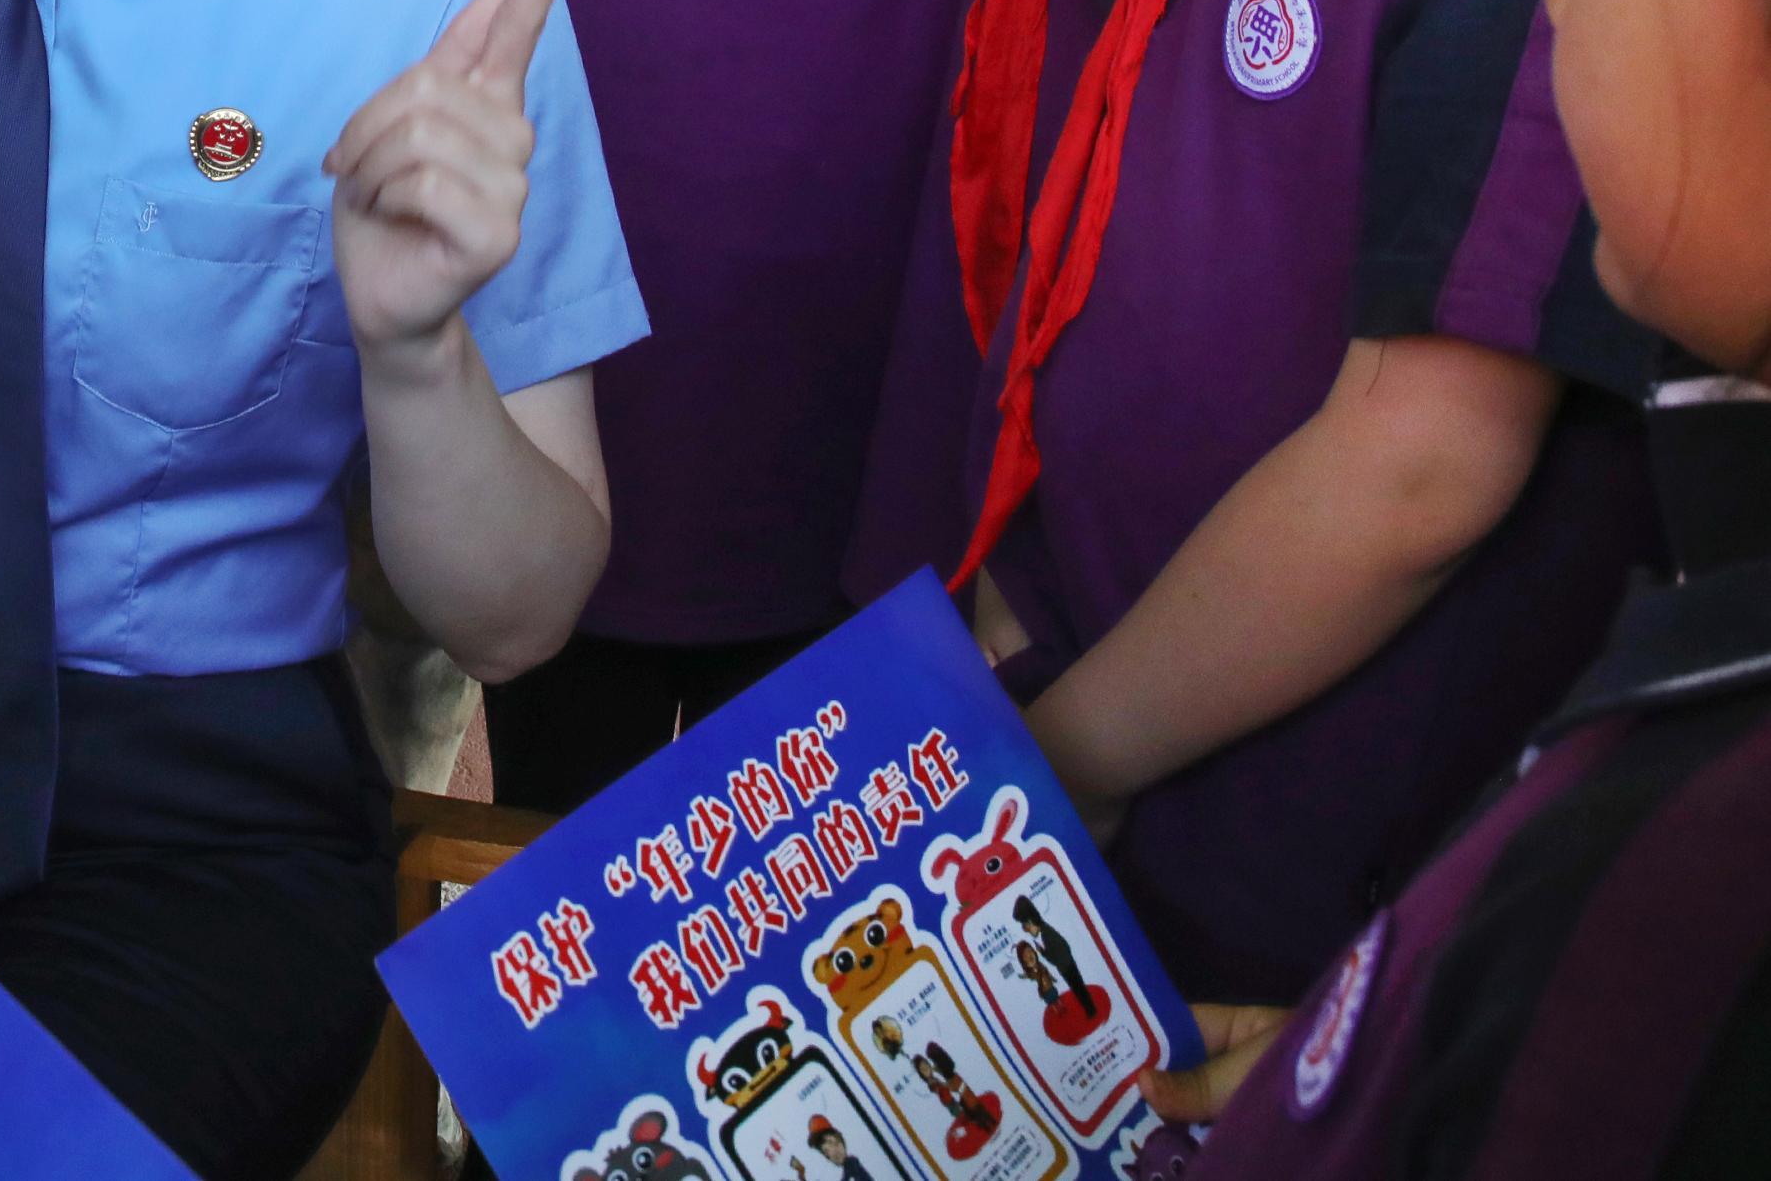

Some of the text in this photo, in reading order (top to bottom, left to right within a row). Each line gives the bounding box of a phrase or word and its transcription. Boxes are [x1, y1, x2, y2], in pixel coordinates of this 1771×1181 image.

[492, 898, 598, 1031] 保护
[628, 727, 971, 1029] 我们共同的责任
